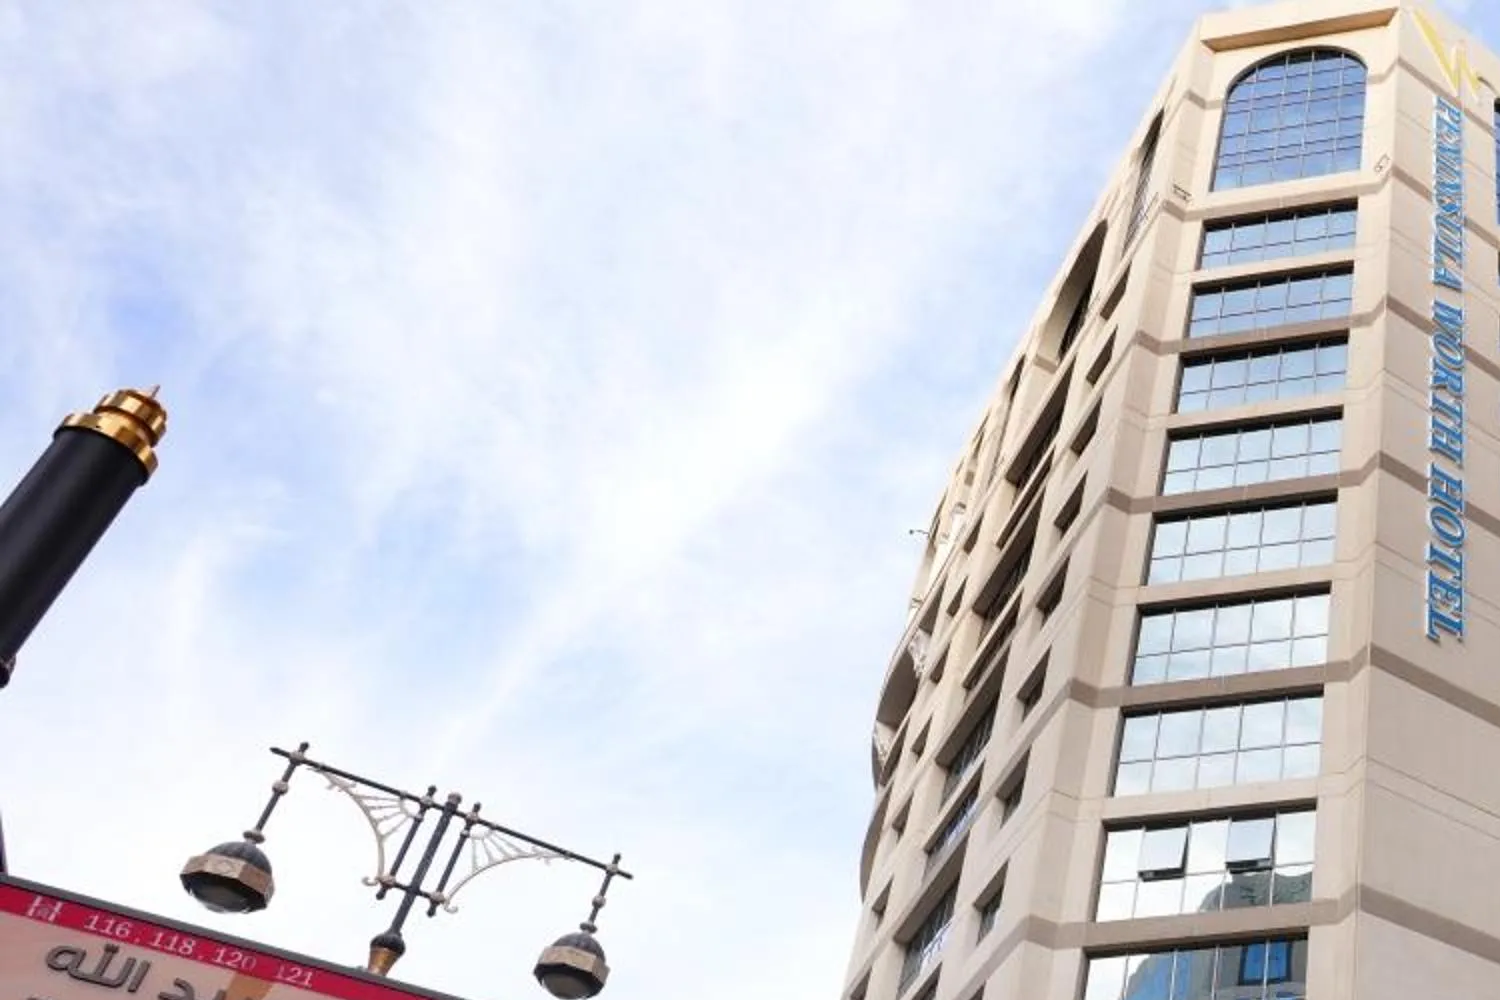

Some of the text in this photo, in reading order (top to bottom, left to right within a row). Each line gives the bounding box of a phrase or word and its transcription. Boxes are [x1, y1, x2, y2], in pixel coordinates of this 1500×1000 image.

[1426, 95, 1466, 642] PENINSULA WORTH HOTEL
[45, 943, 153, 994] الله
[274, 964, 313, 988] 121
